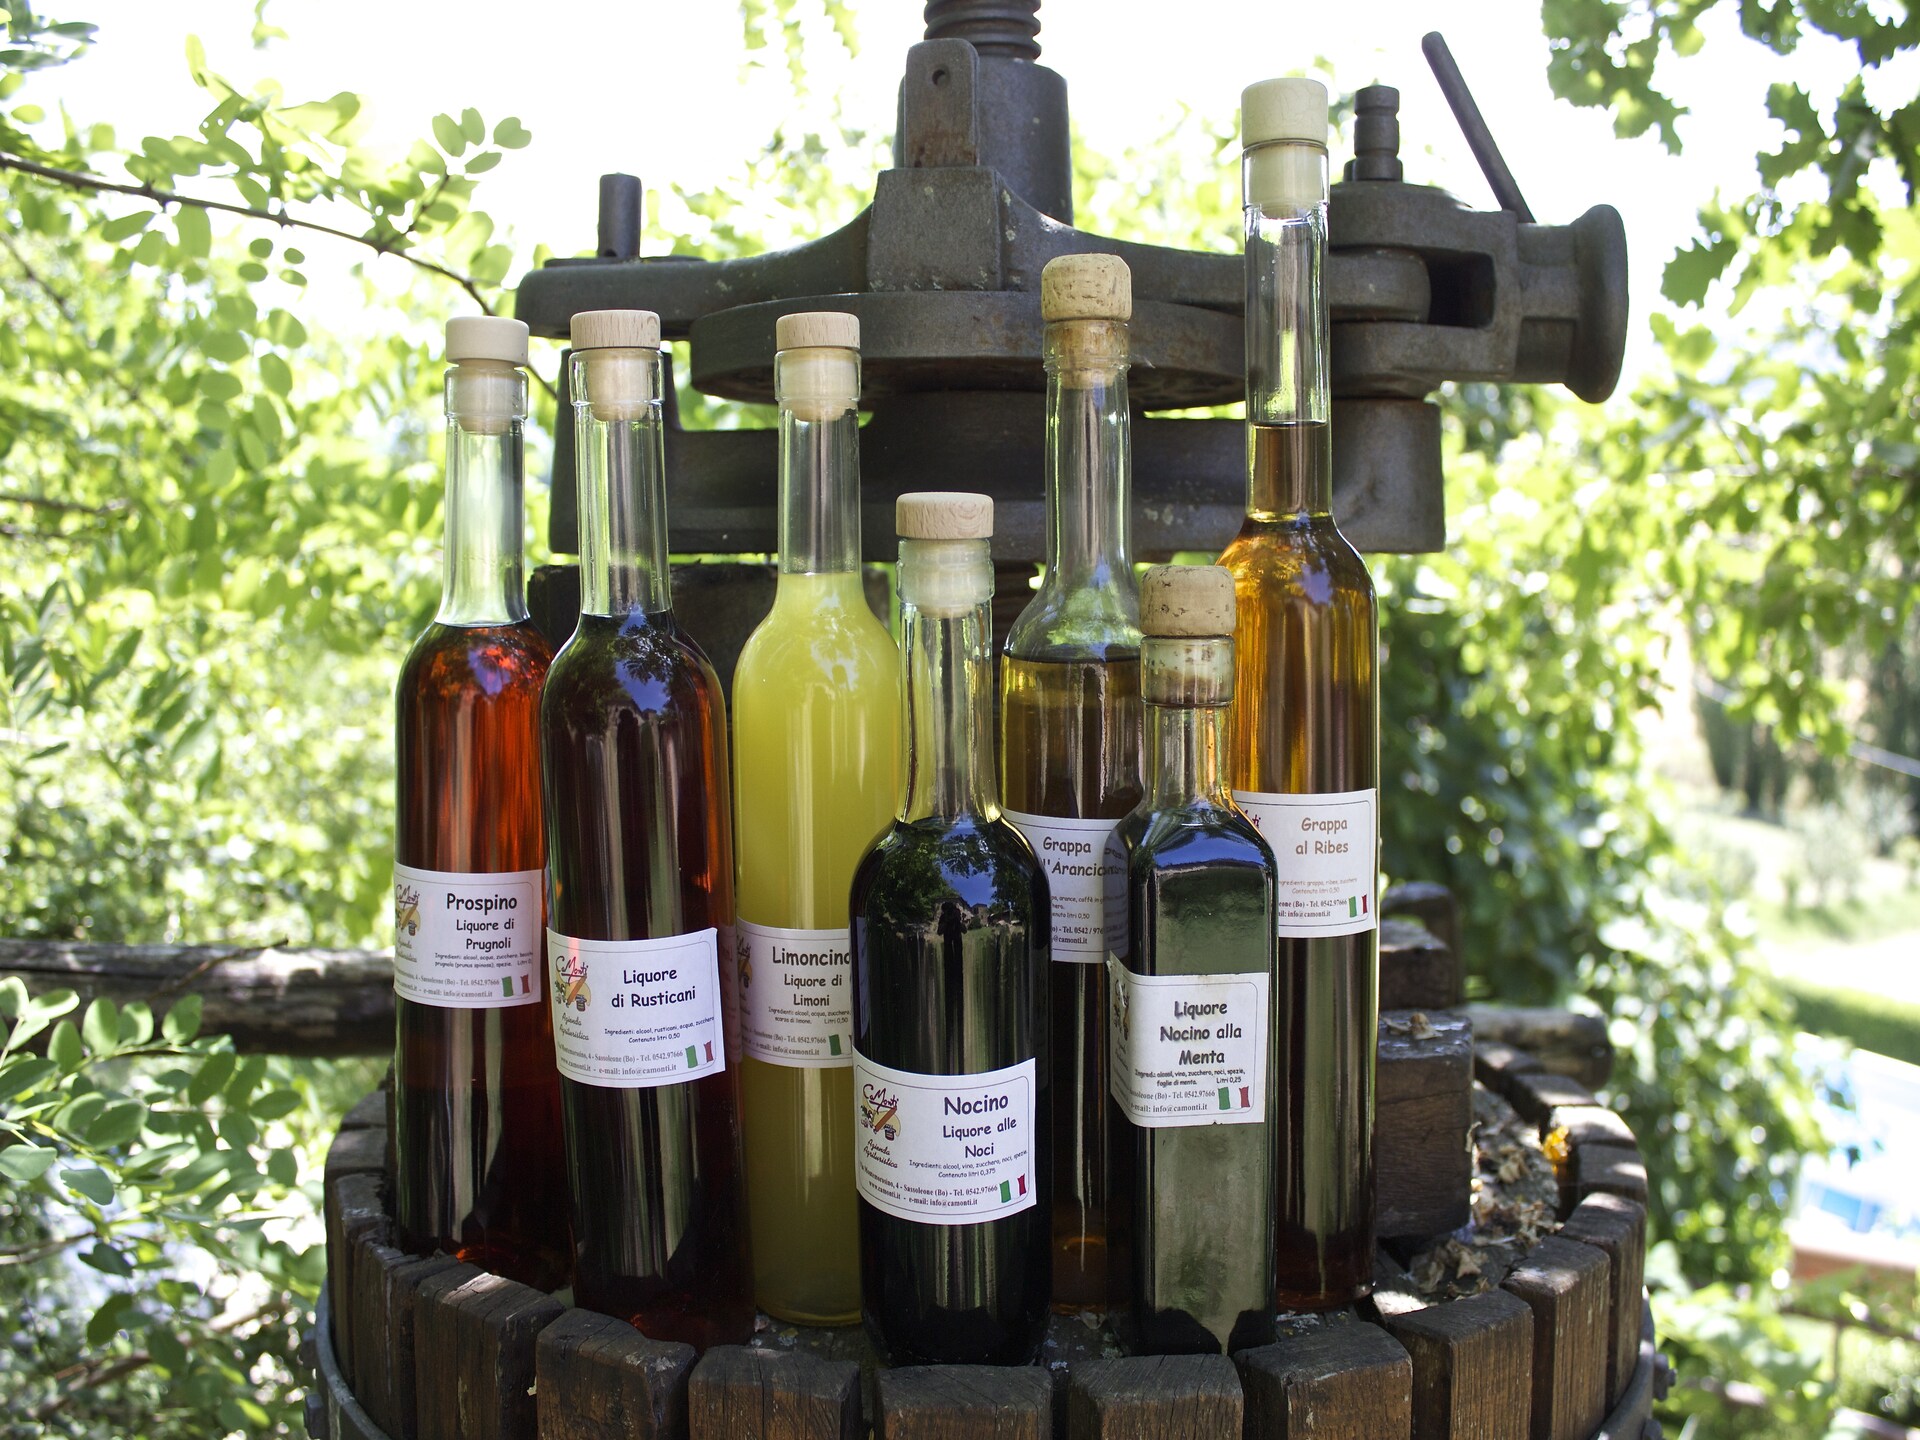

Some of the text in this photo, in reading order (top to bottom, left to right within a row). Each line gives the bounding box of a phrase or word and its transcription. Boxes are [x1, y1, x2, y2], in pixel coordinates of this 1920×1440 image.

[1301, 817, 1347, 834] Grappa
[1043, 836, 1091, 857] Grappa
[1295, 841, 1349, 855] al Ribes
[447, 893, 517, 916] Prospino
[456, 918, 514, 934] Liquore di
[466, 937, 511, 953] Prugnoli
[623, 969, 677, 987] Liquore
[784, 973, 842, 989] Liquore di
[611, 985, 696, 1008] di Rusticani
[793, 993, 830, 1006] Limoni
[1174, 1000, 1228, 1020] Liquore
[1159, 1023, 1242, 1042] Nocino alla
[1178, 1049, 1225, 1066] Menta
[944, 1094, 1009, 1116] Nocino
[943, 1117, 1017, 1141] Liquore alle
[868, 1139, 890, 1155] Azienda
[965, 1142, 994, 1158] Noci
[863, 1146, 898, 1168] Agrituristica
